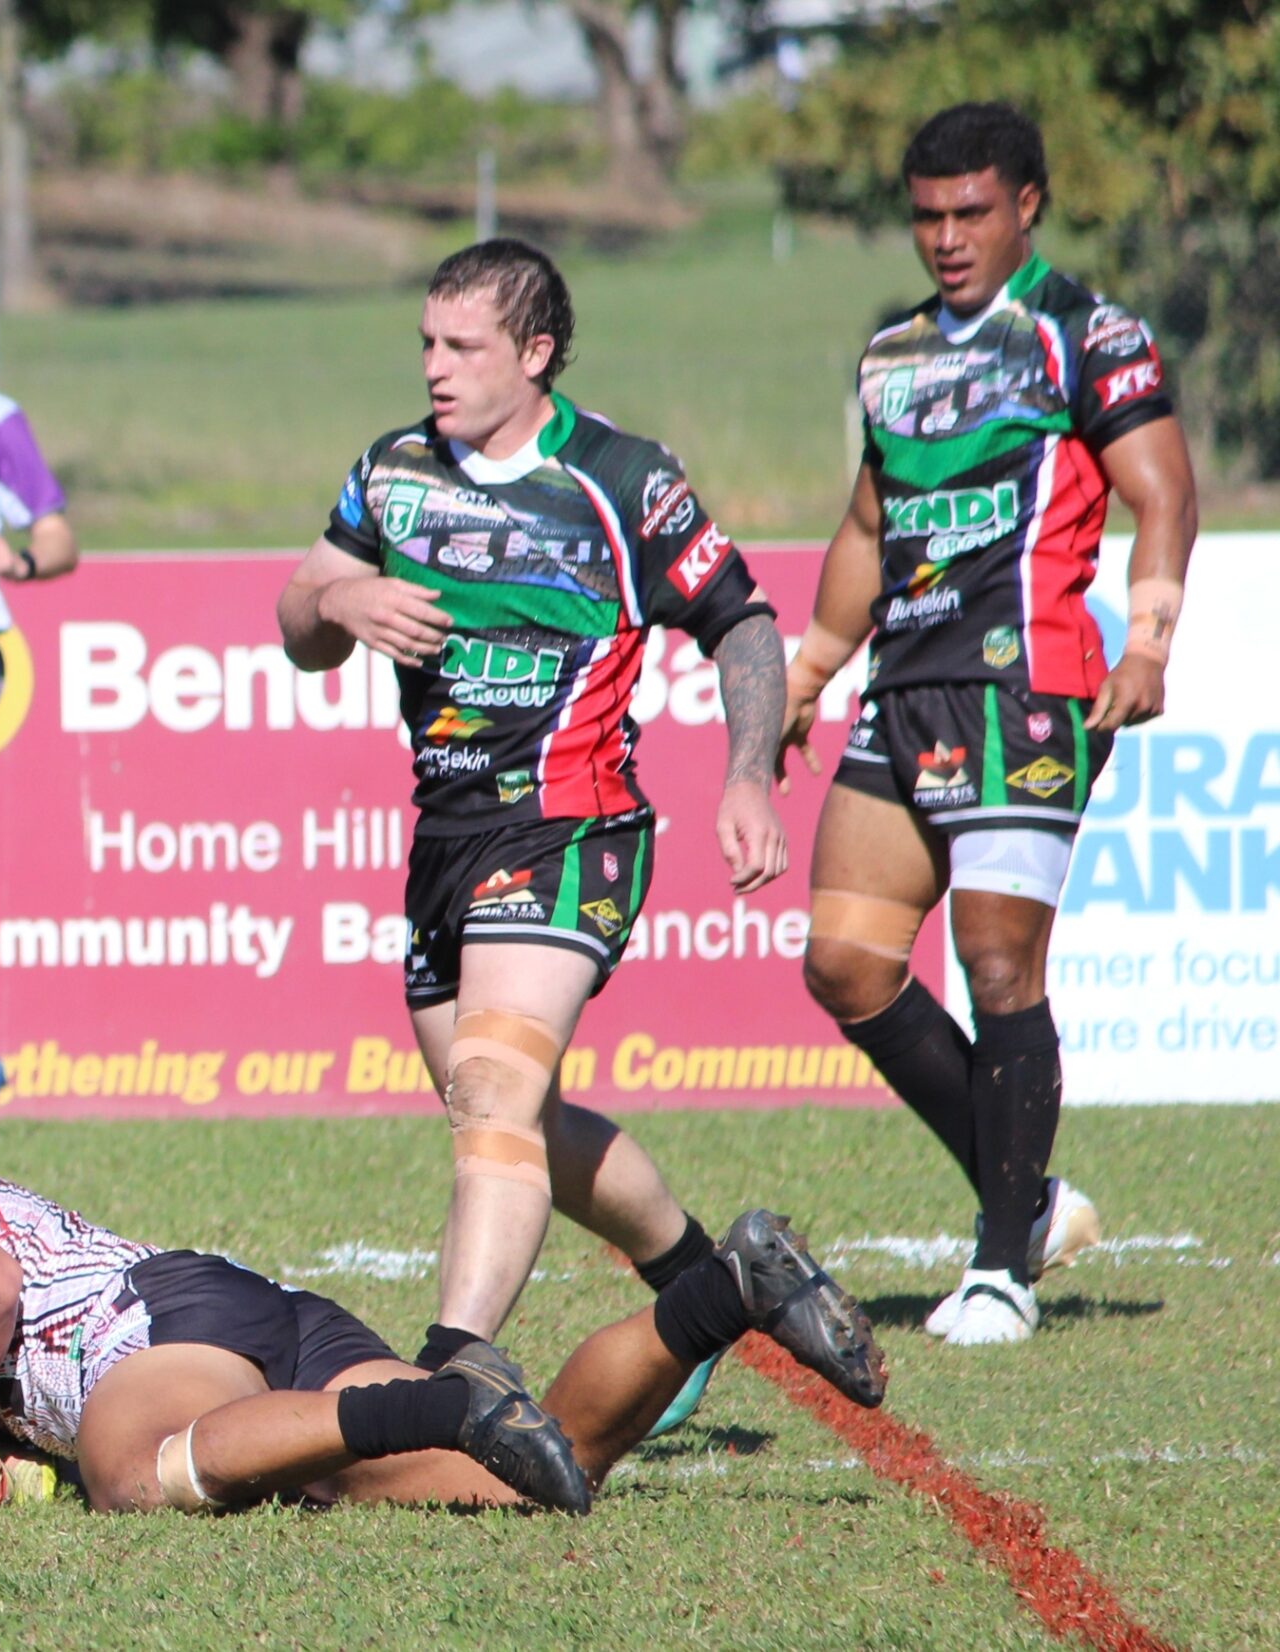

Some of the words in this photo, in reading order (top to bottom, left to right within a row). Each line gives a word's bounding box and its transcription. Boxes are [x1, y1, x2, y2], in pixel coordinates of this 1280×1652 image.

[440, 634, 564, 685] NDI
[60, 621, 412, 750] Bendi
[449, 681, 556, 707] GROUP
[417, 743, 490, 771] urdekin
[1082, 733, 1280, 818] URA
[89, 810, 281, 872] Home
[302, 807, 403, 870] Hill
[1057, 827, 1280, 915] ANK
[322, 902, 407, 965] Ba
[622, 896, 813, 962] anche
[1047, 955, 1154, 987] rmer
[1172, 940, 1280, 987] focu
[1060, 1014, 1140, 1053] ure
[236, 1050, 336, 1095] our
